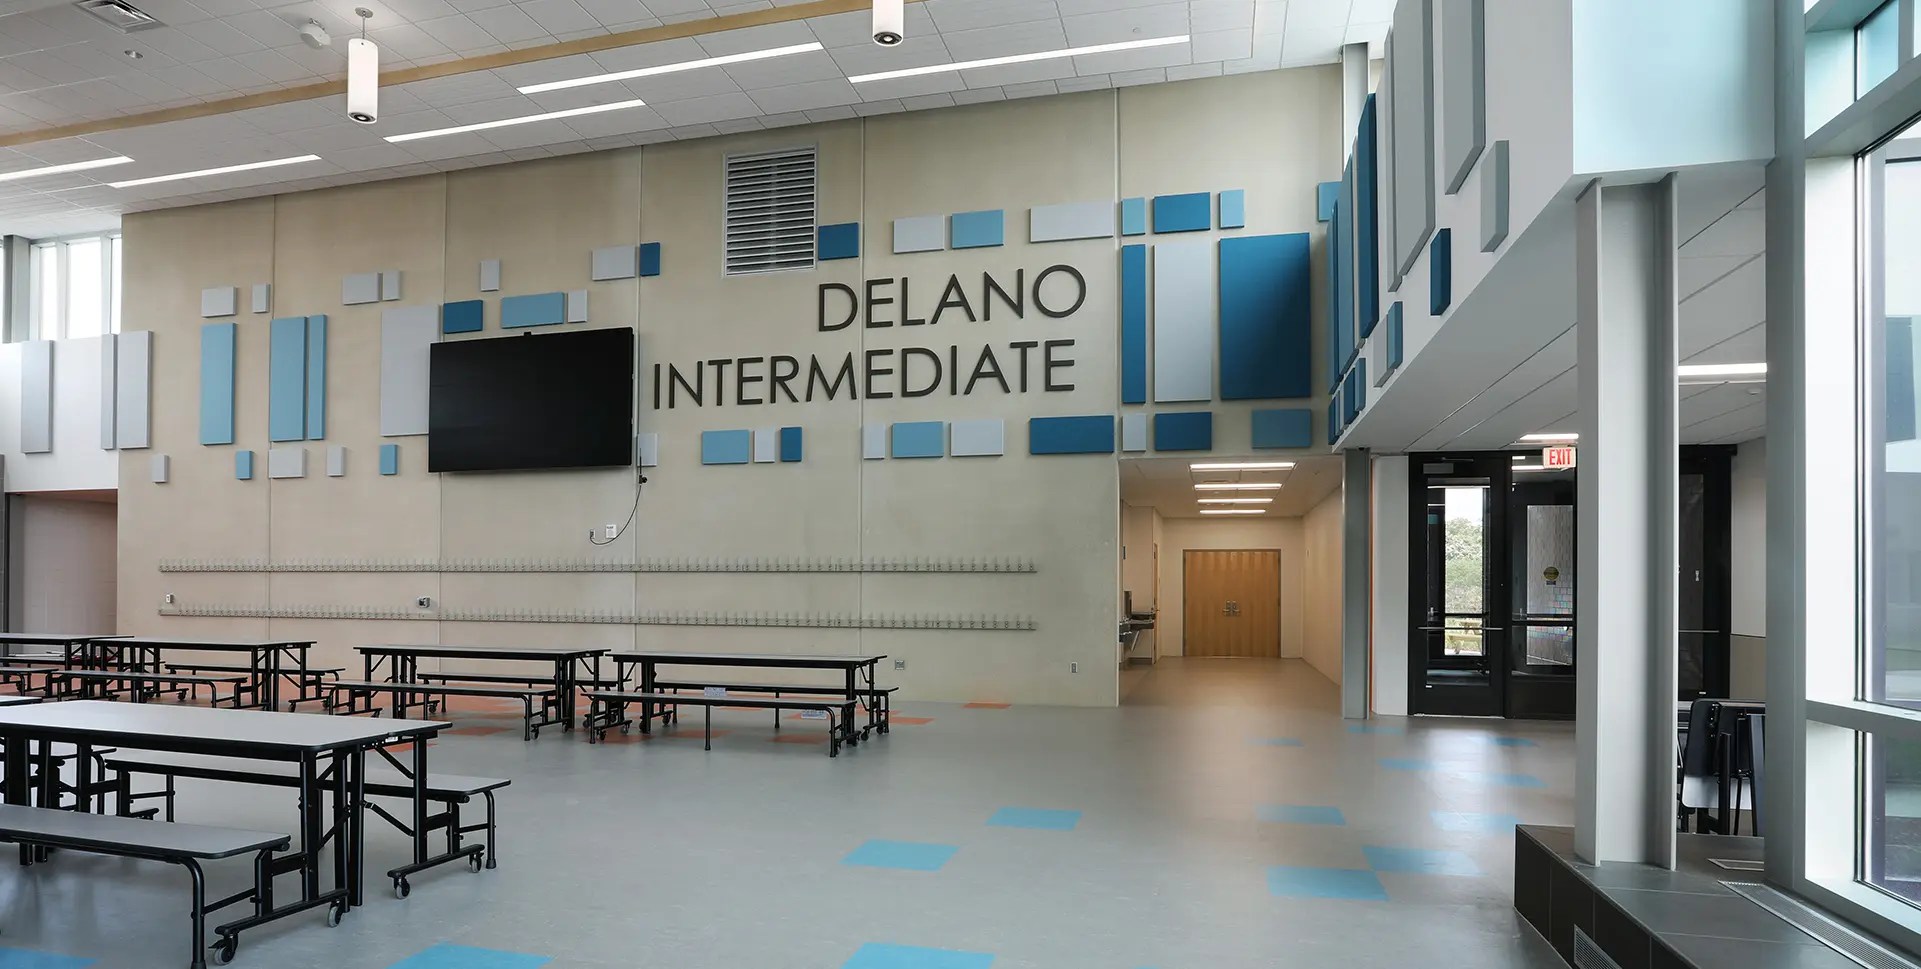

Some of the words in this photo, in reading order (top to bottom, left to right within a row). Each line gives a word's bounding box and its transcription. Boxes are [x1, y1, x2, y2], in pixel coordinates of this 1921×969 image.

[818, 264, 1087, 332] DELANO
[653, 339, 1075, 410] INTERMEDIATE
[1549, 449, 1571, 465] EXIT
